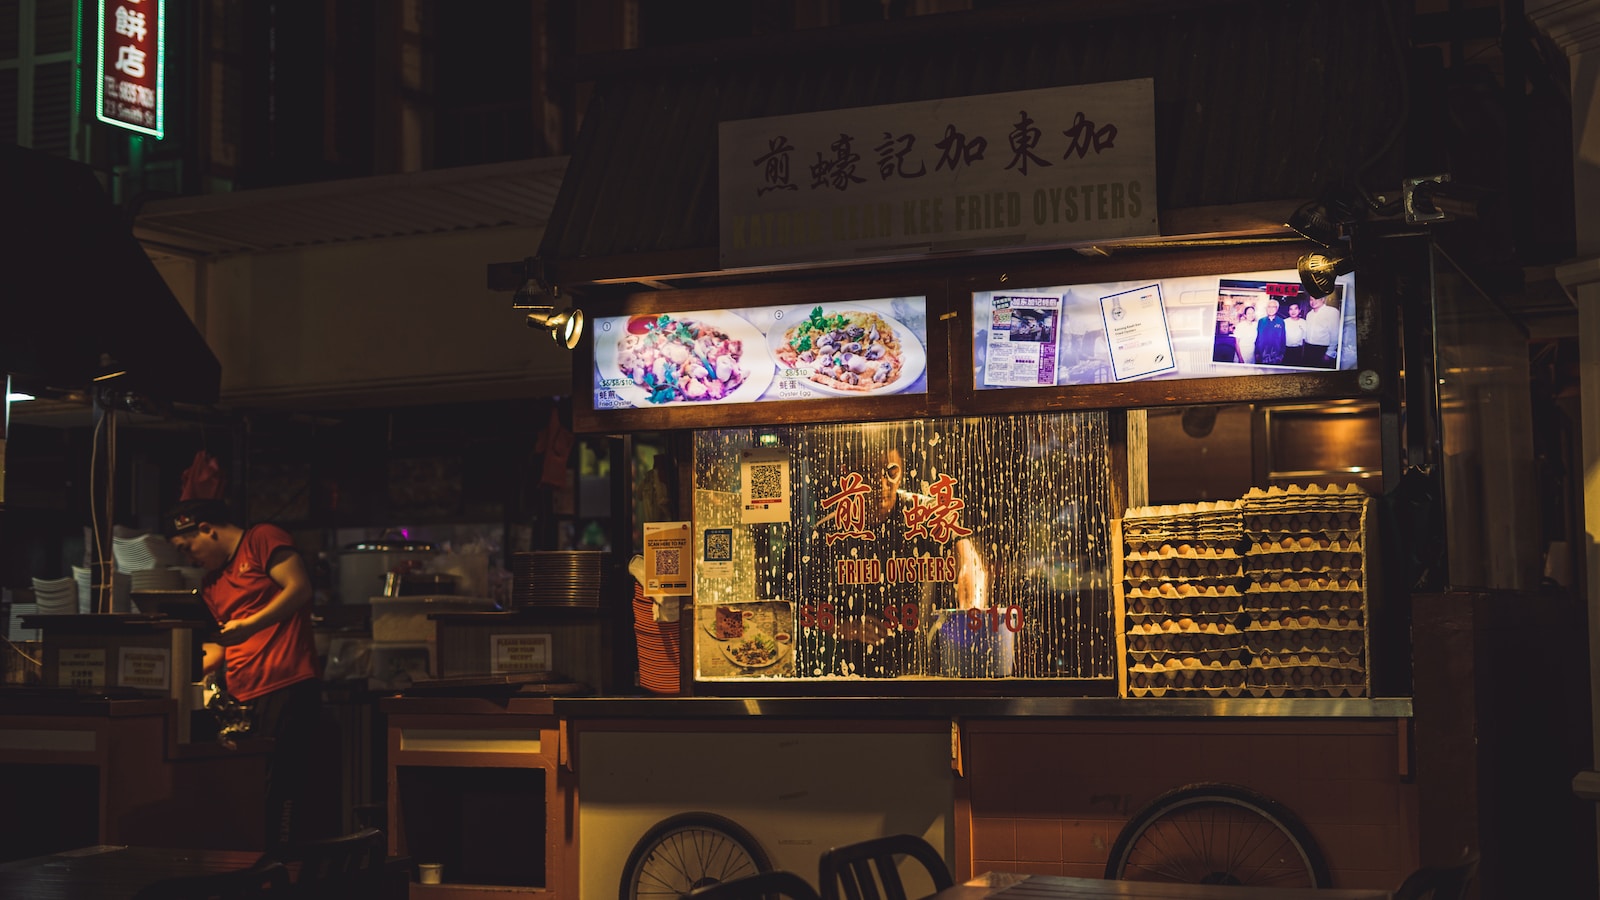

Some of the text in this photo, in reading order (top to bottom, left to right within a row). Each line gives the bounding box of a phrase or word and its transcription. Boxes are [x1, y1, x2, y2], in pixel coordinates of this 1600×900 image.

[115, 0, 147, 78] 餅店
[903, 197, 945, 236] KEE
[955, 191, 1021, 231] FRIED
[1033, 180, 1142, 225] OYSTERS
[599, 400, 613, 408] Fried
[779, 389, 811, 398] Oyster Egg
[838, 556, 956, 585] FRIED OYSTERS
[801, 603, 1024, 633] $6 $8 $10
